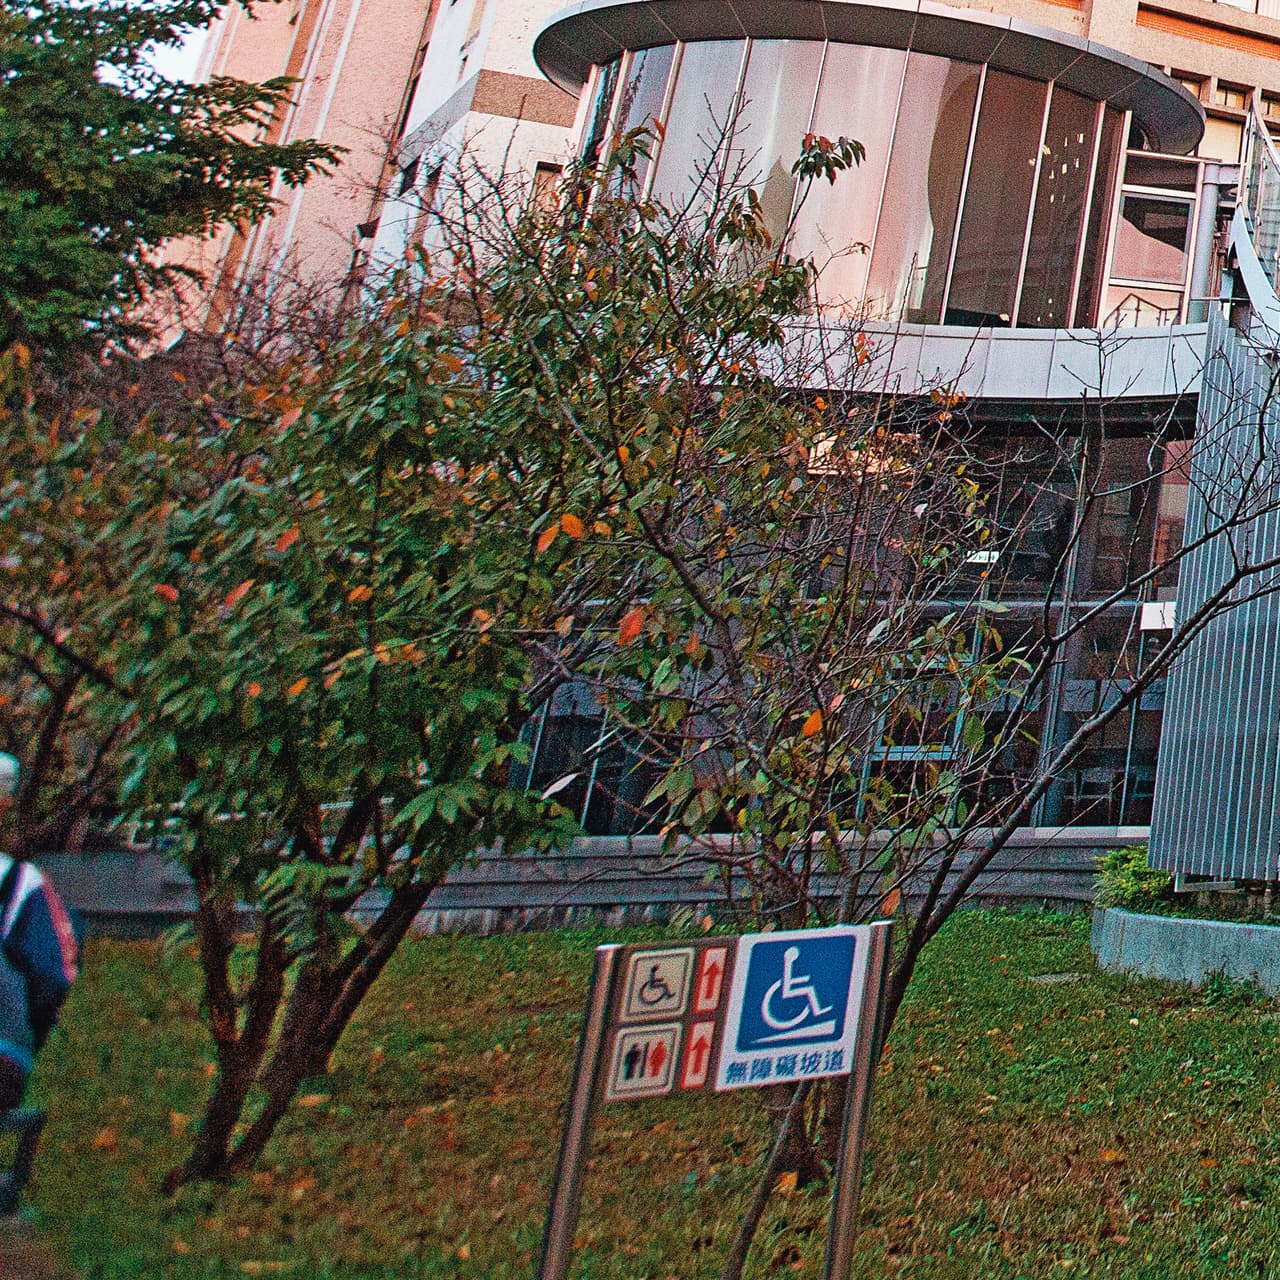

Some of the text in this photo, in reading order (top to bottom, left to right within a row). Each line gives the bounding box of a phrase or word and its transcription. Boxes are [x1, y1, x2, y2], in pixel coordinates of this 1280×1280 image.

[726, 1048, 844, 1083] 無障礙坡道
